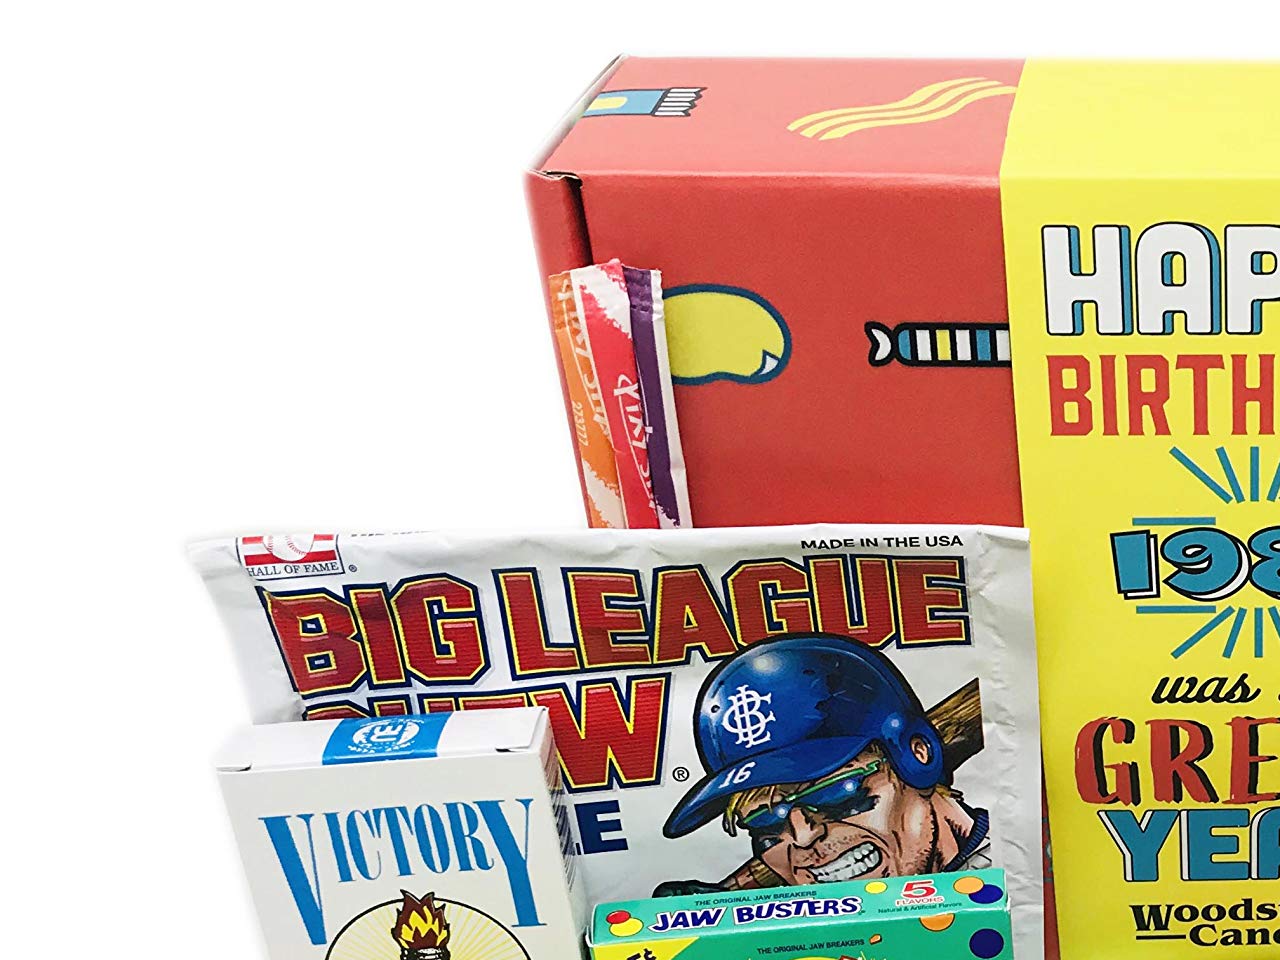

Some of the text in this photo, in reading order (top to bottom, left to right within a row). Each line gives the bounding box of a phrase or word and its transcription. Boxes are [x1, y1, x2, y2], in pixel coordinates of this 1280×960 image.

[800, 534, 964, 550] MADE IN THE USA
[247, 562, 339, 577] HALL OF FAME
[254, 553, 972, 699] BIG LEAGUE
[1151, 672, 1262, 705] was
[717, 761, 756, 790] 16
[257, 798, 548, 946] VICTORY
[695, 890, 818, 907] THE ORIGINAL JAW BREAKERS
[902, 880, 937, 899] 5
[896, 896, 945, 906] FLAVORS
[651, 896, 864, 933] JAW BUSTERS
[757, 938, 865, 956] THE ORIGINAL JAW BREAKERS
